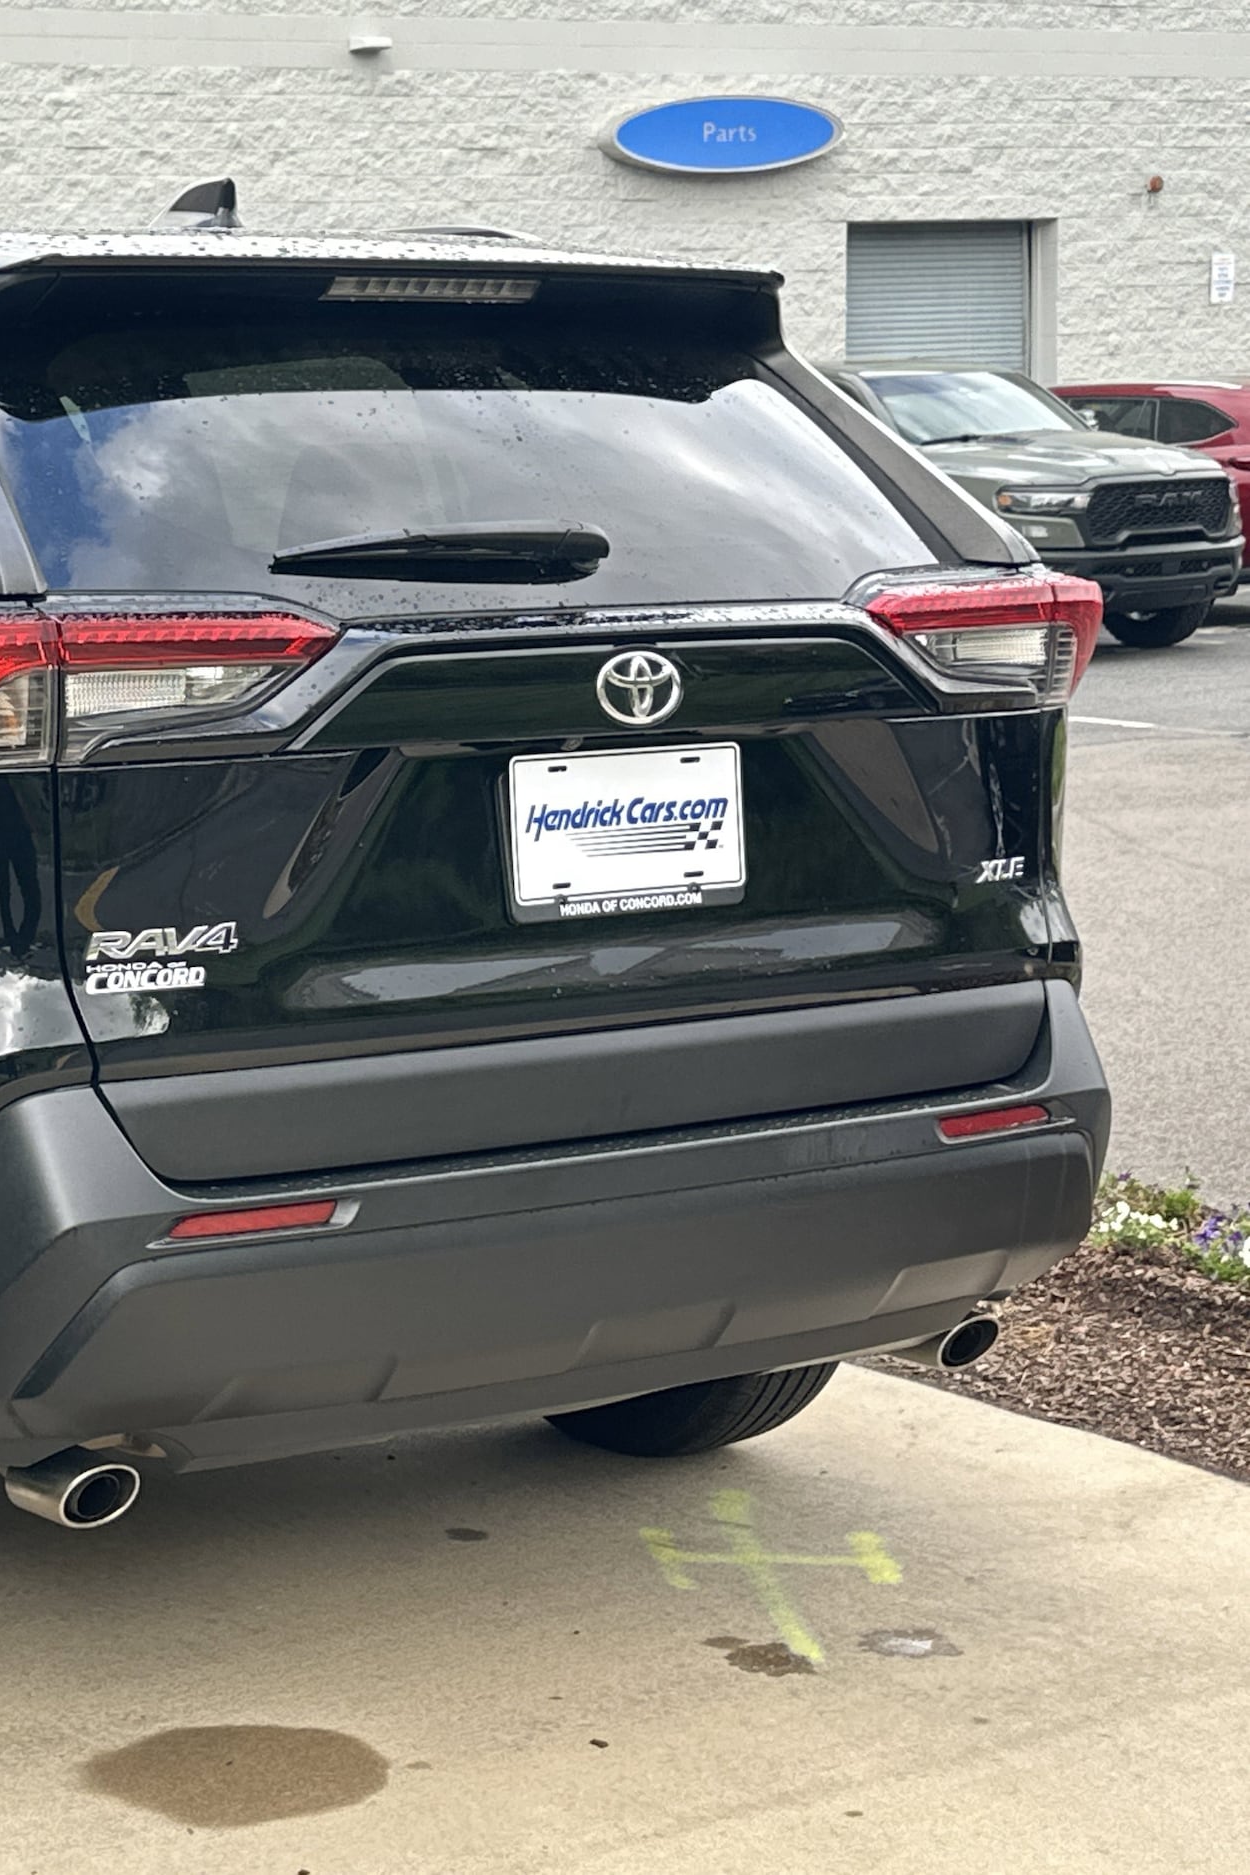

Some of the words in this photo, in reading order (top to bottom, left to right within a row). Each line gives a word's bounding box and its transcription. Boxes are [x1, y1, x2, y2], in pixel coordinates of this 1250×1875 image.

[702, 121, 758, 143] Parts
[975, 856, 1025, 884] XLE
[559, 902, 600, 917] HONDA
[602, 900, 618, 912] OF
[619, 892, 703, 911] CONCORD.COM
[86, 921, 239, 961] RAV4
[86, 961, 165, 973] HONDA
[85, 966, 205, 995] CONCORD
